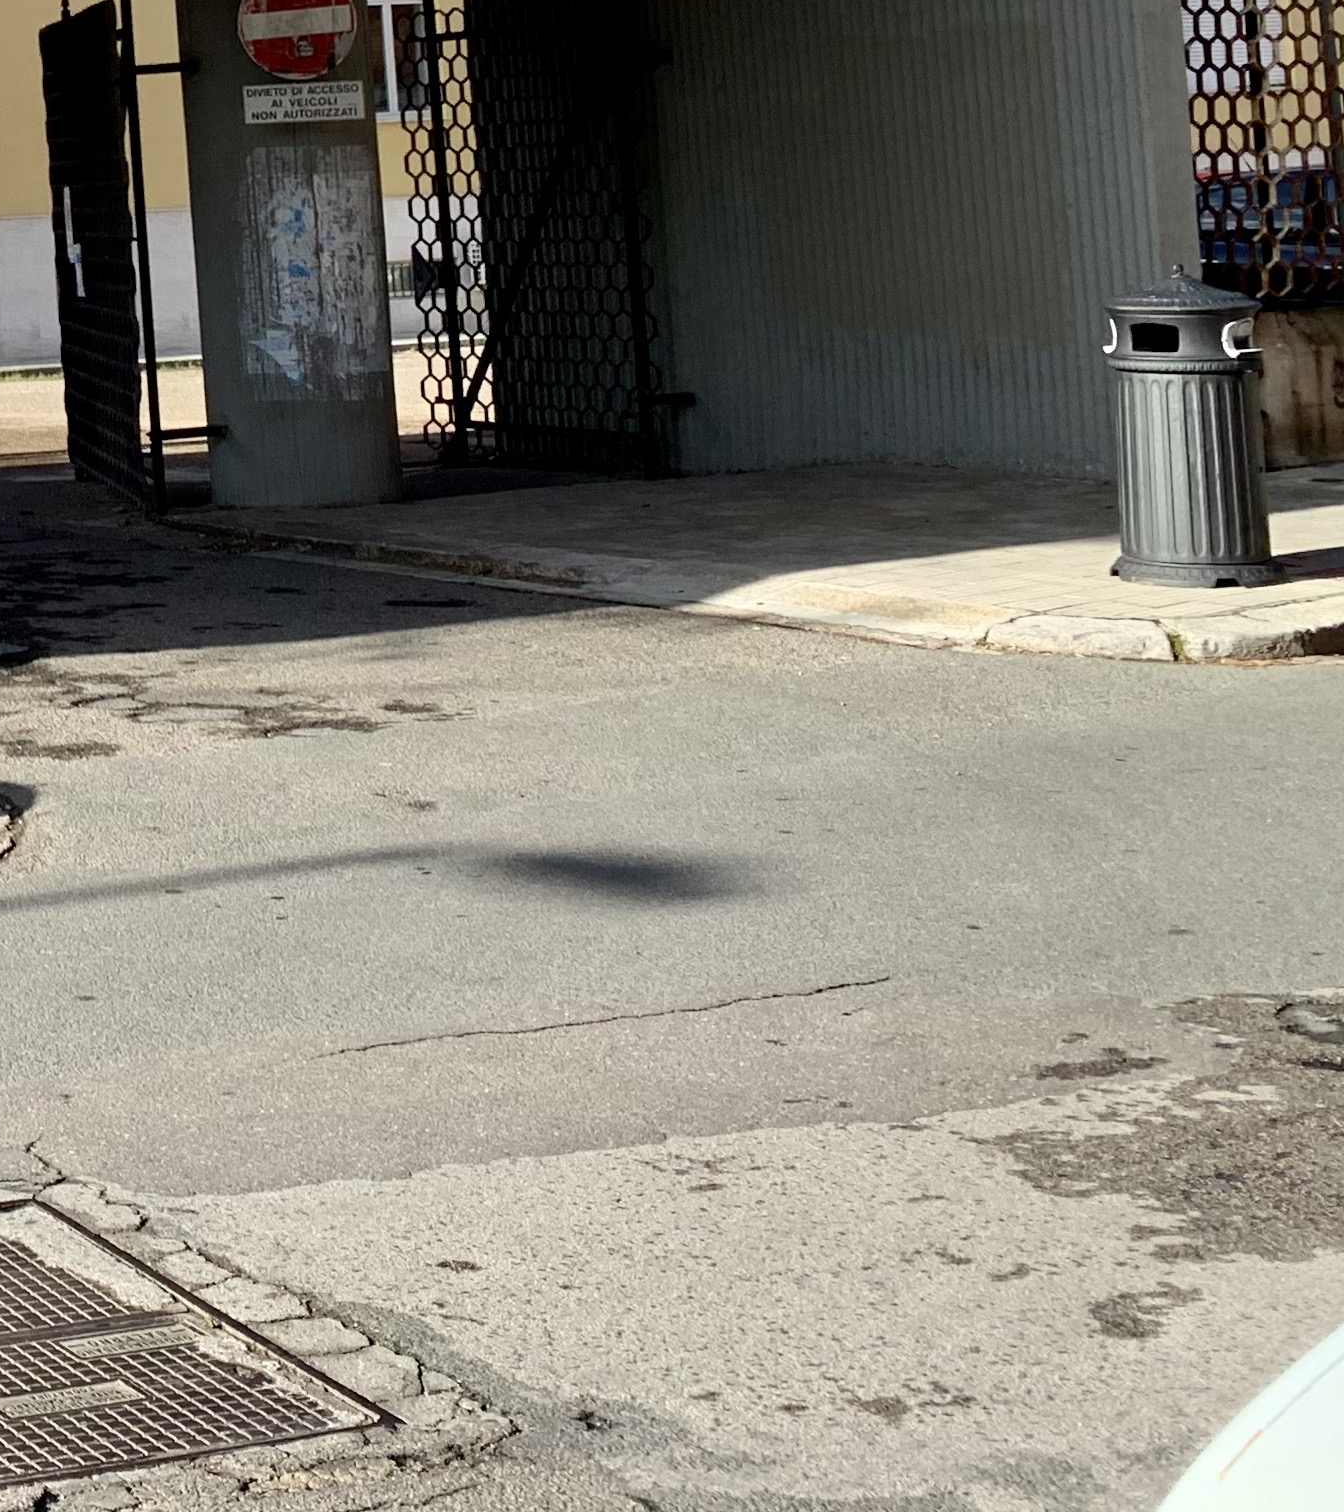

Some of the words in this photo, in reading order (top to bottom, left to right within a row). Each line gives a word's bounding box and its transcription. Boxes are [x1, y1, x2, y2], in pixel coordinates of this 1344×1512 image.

[246, 87, 288, 98] DIVIETO
[291, 86, 303, 96] DI
[307, 83, 360, 95] ACCESSO
[288, 96, 339, 108] VEICOLI
[251, 110, 278, 121] NON
[282, 107, 358, 120] AUTORIZZATI
